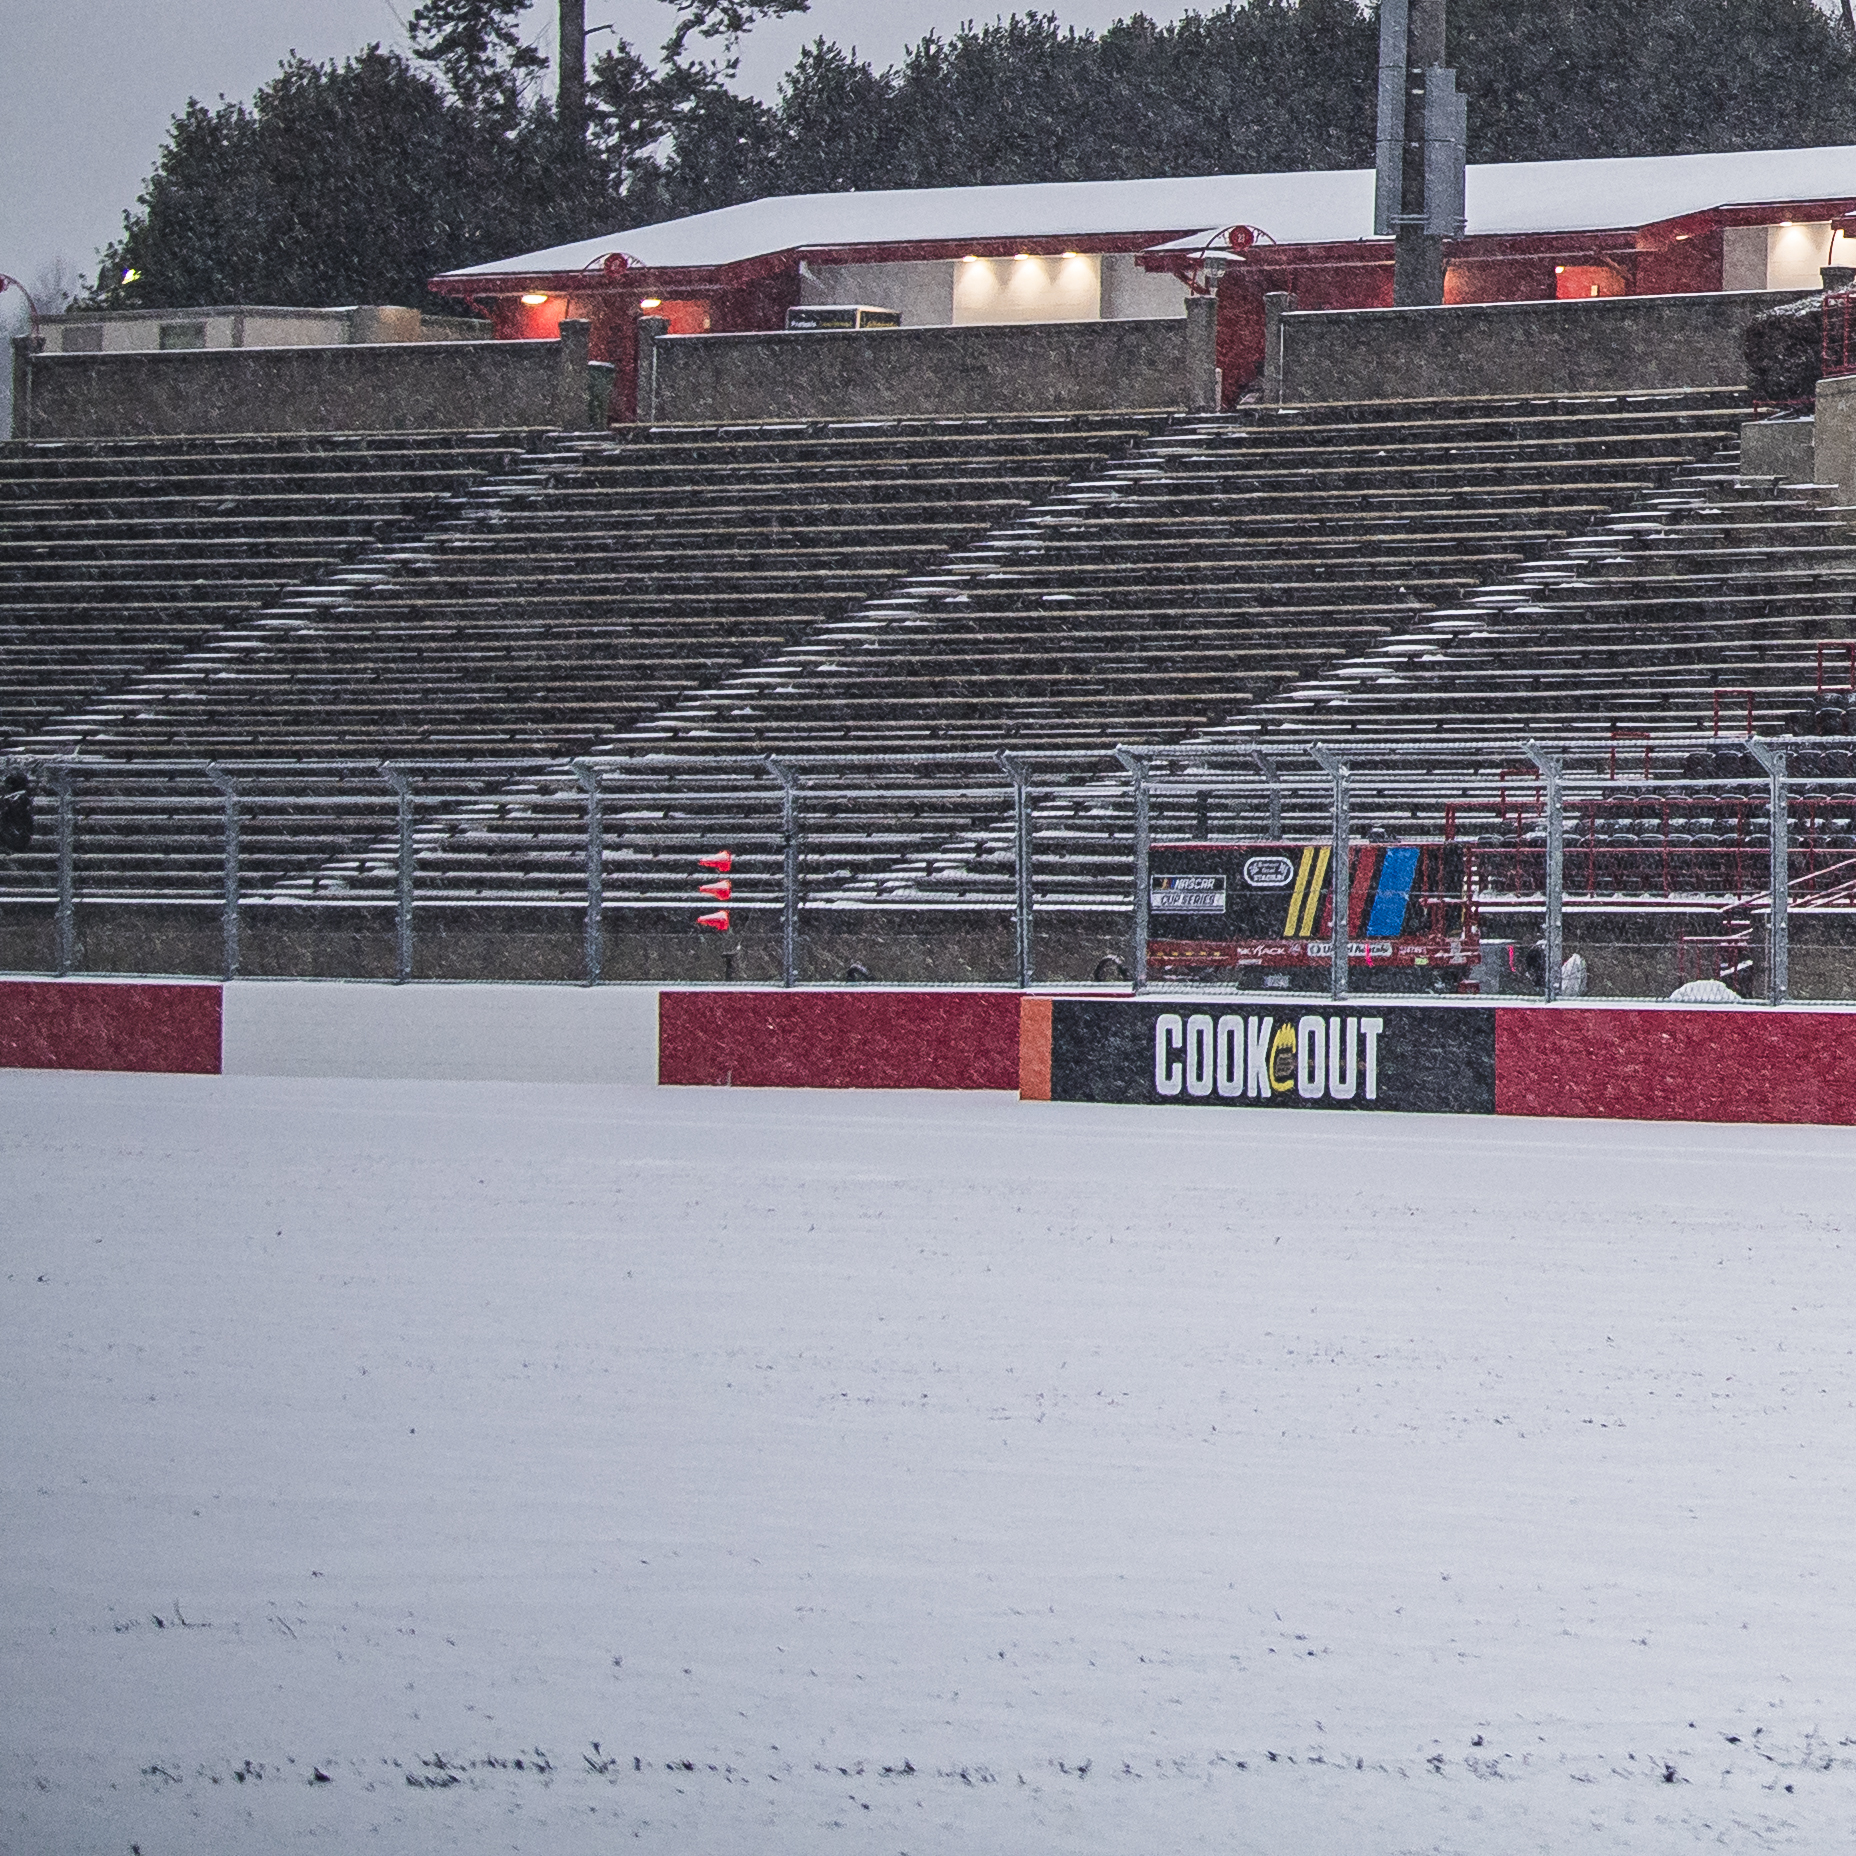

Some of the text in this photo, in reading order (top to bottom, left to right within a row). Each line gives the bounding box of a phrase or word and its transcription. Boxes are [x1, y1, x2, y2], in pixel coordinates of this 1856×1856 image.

[1175, 878, 1216, 890] NASCAR
[1160, 894, 1216, 905] CUP SERIES
[1155, 1013, 1384, 1100] COOK OUT
